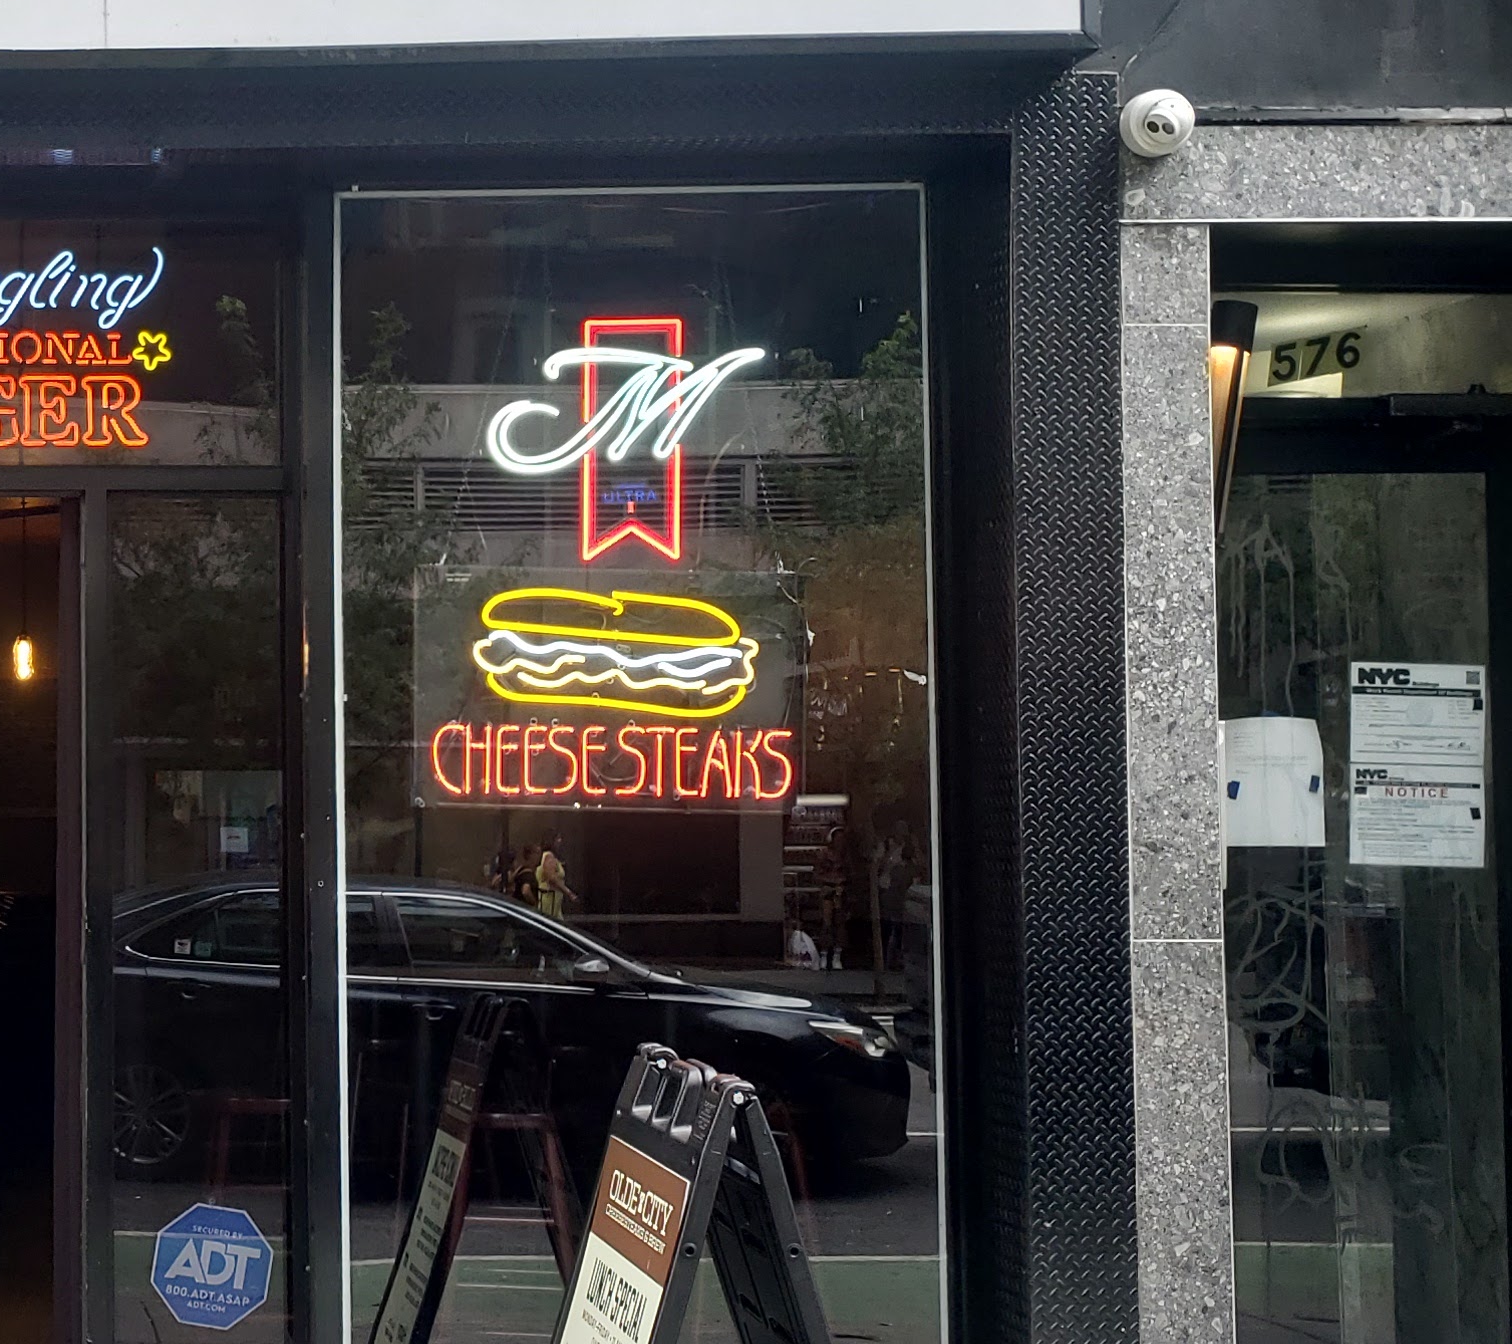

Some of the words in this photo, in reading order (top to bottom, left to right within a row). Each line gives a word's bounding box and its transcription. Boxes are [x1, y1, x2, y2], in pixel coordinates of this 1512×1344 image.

[1272, 332, 1361, 381] 576
[602, 489, 657, 503] ULTRA
[1358, 667, 1410, 685] NYC
[1356, 768, 1388, 780] NYC
[1384, 787, 1448, 799] NOTICE
[610, 1170, 641, 1214] OLDE
[642, 1192, 673, 1235] CITY
[192, 1225, 230, 1237] SECURED
[164, 1238, 261, 1290] ADT
[165, 1284, 250, 1307] 800.ADT.ASAP
[587, 1259, 617, 1315] LUNCH
[611, 1279, 646, 1342] SPECIAL
[187, 1300, 226, 1313] ADT.COM
